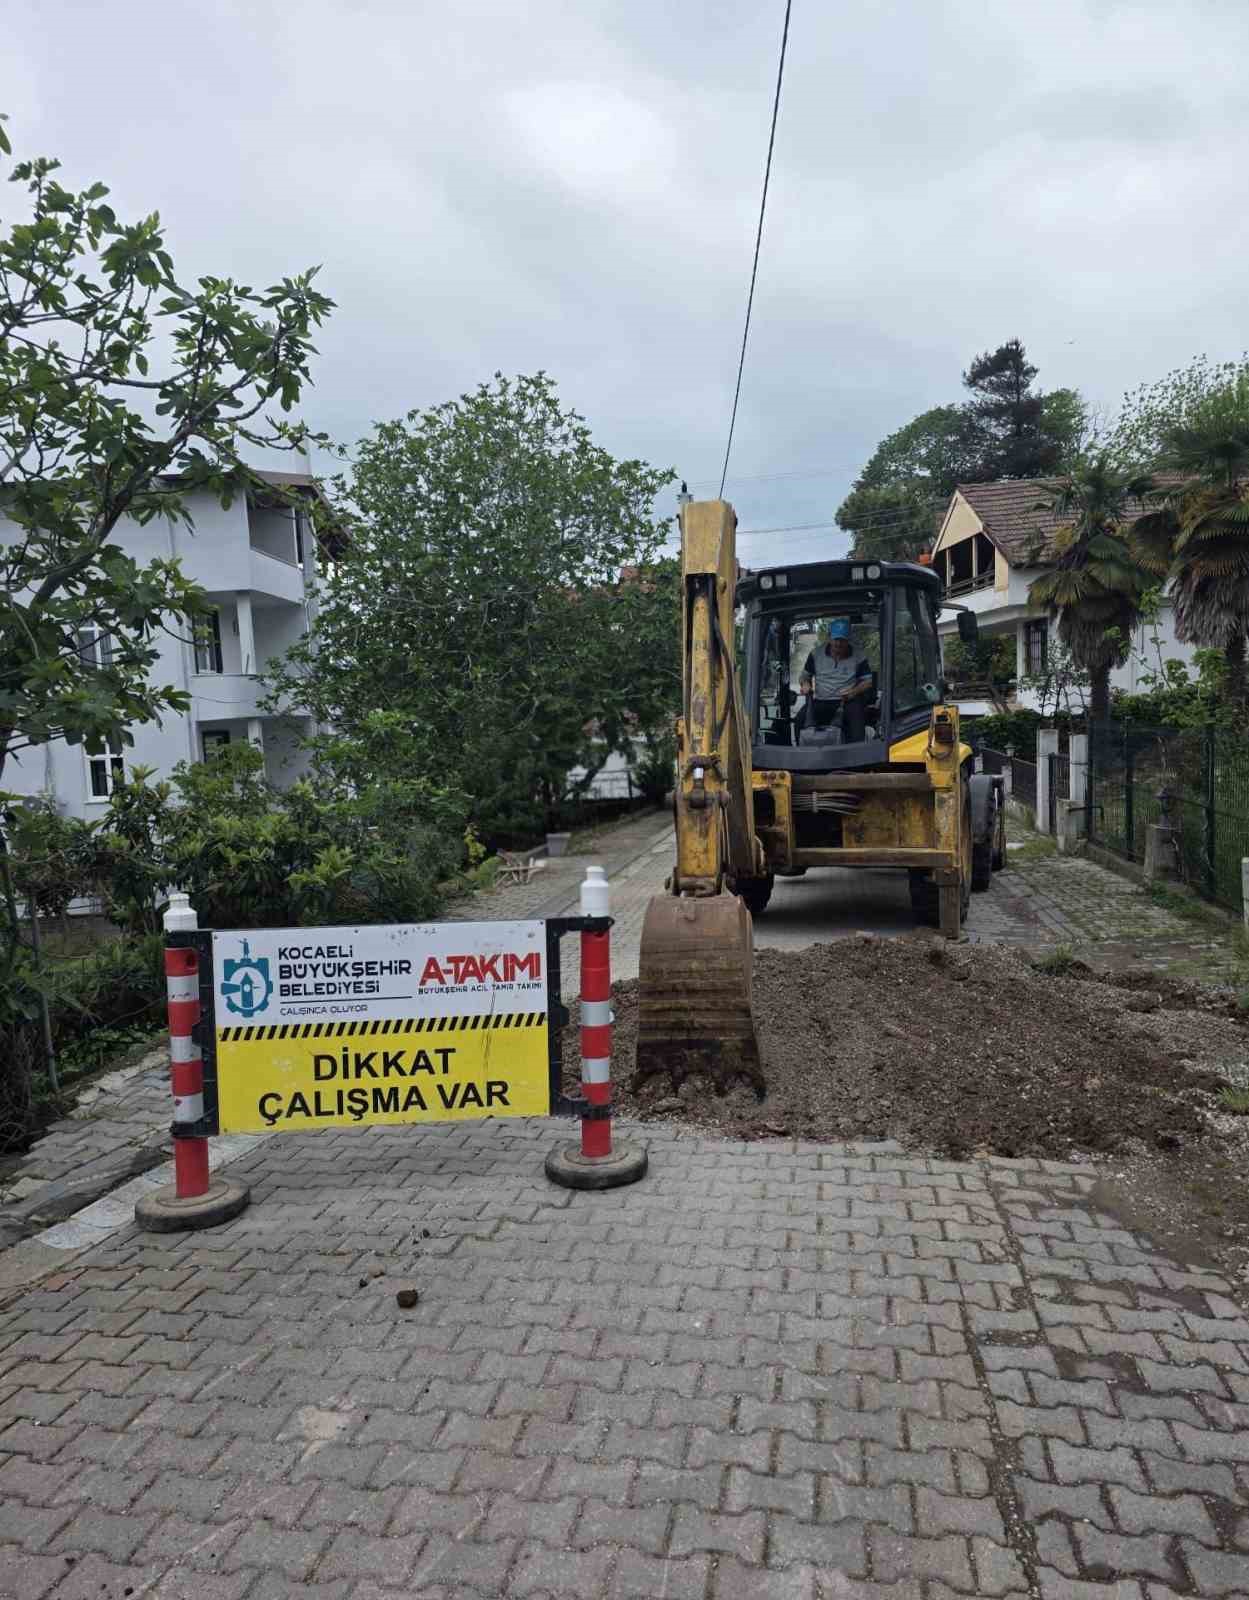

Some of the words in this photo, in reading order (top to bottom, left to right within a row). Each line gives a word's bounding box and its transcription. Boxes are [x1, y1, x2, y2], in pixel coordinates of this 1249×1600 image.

[278, 945, 353, 961] KOCAELİ
[279, 959, 412, 979] BÜYÜKŞEHİR
[419, 952, 541, 986] A-TAKIMI
[279, 980, 380, 997] BELEDİYESİ
[331, 1004, 368, 1015] OLUYOR
[313, 1047, 456, 1081] DİKKAT
[258, 1084, 428, 1125] ÇALIŞMA
[437, 1080, 511, 1109] VAR
